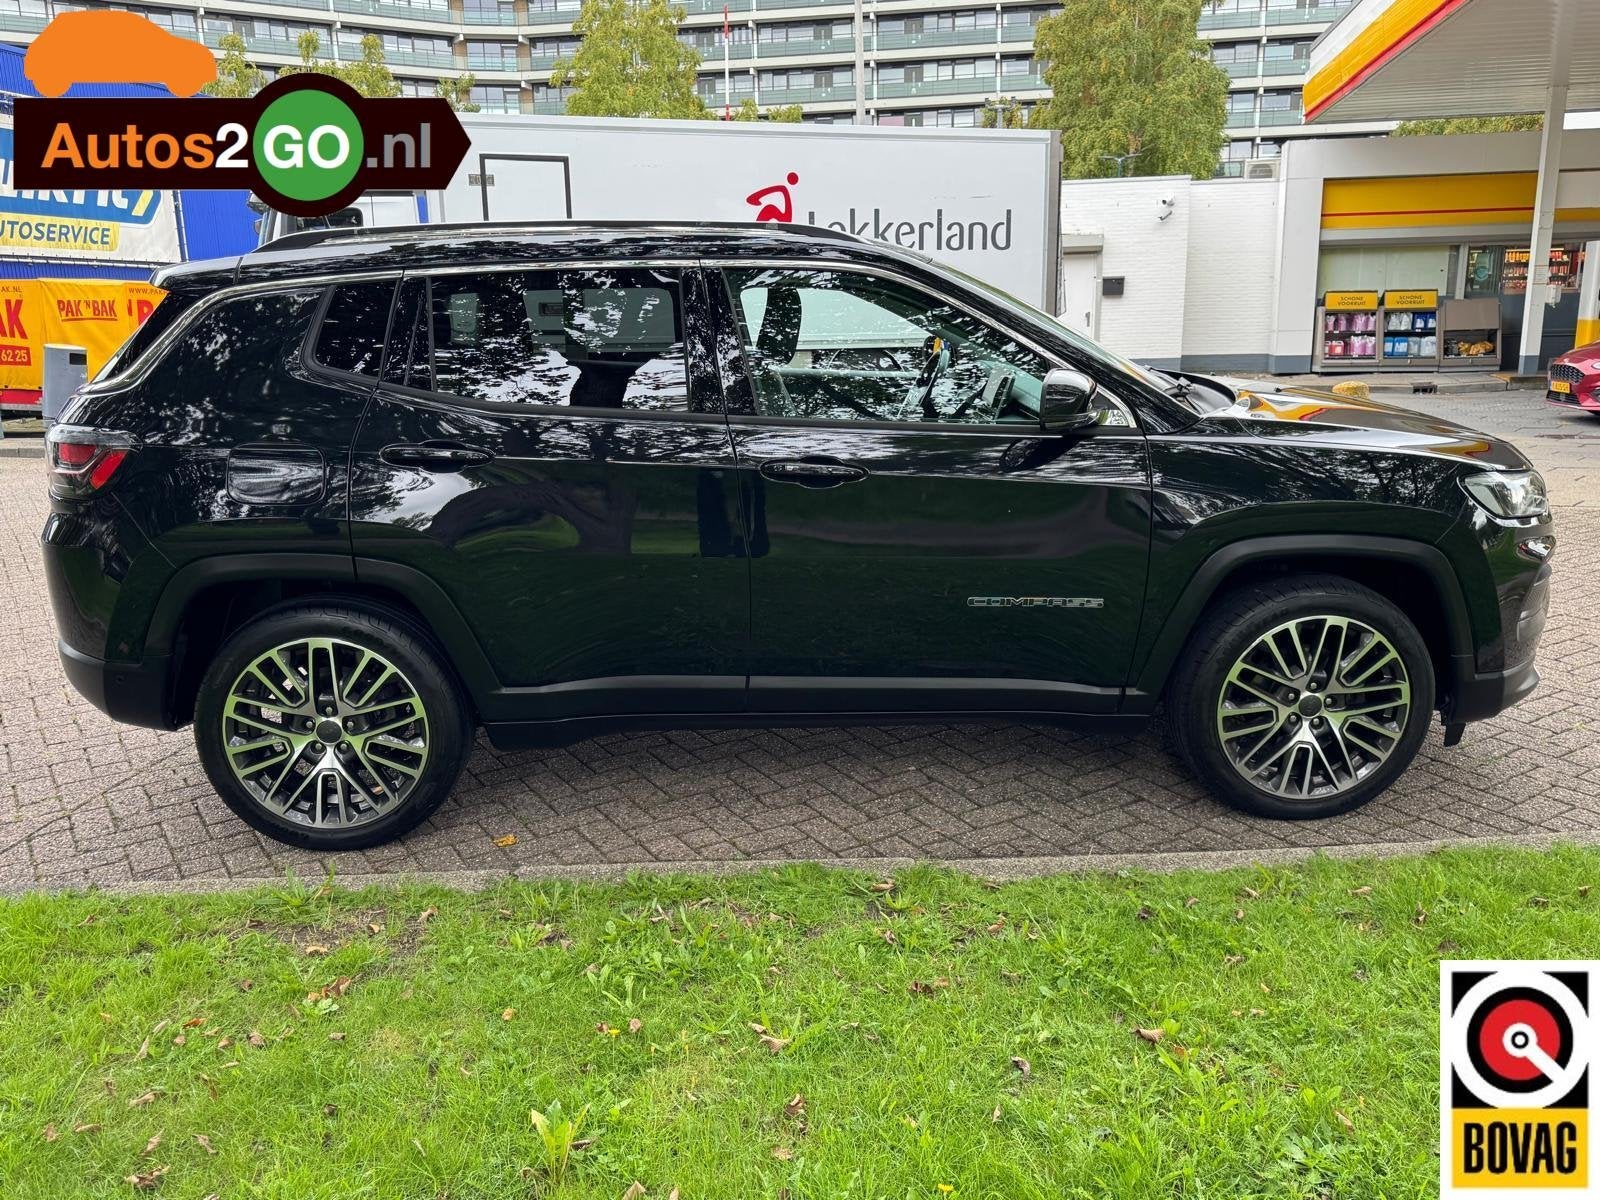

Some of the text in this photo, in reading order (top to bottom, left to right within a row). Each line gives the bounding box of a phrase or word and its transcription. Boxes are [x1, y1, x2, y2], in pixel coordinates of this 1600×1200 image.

[808, 208, 1012, 251] kkerland
[57, 299, 83, 317] PAK
[92, 299, 117, 317] BAK
[1, 351, 27, 362] 62 25
[967, 596, 1105, 608] COMPASS
